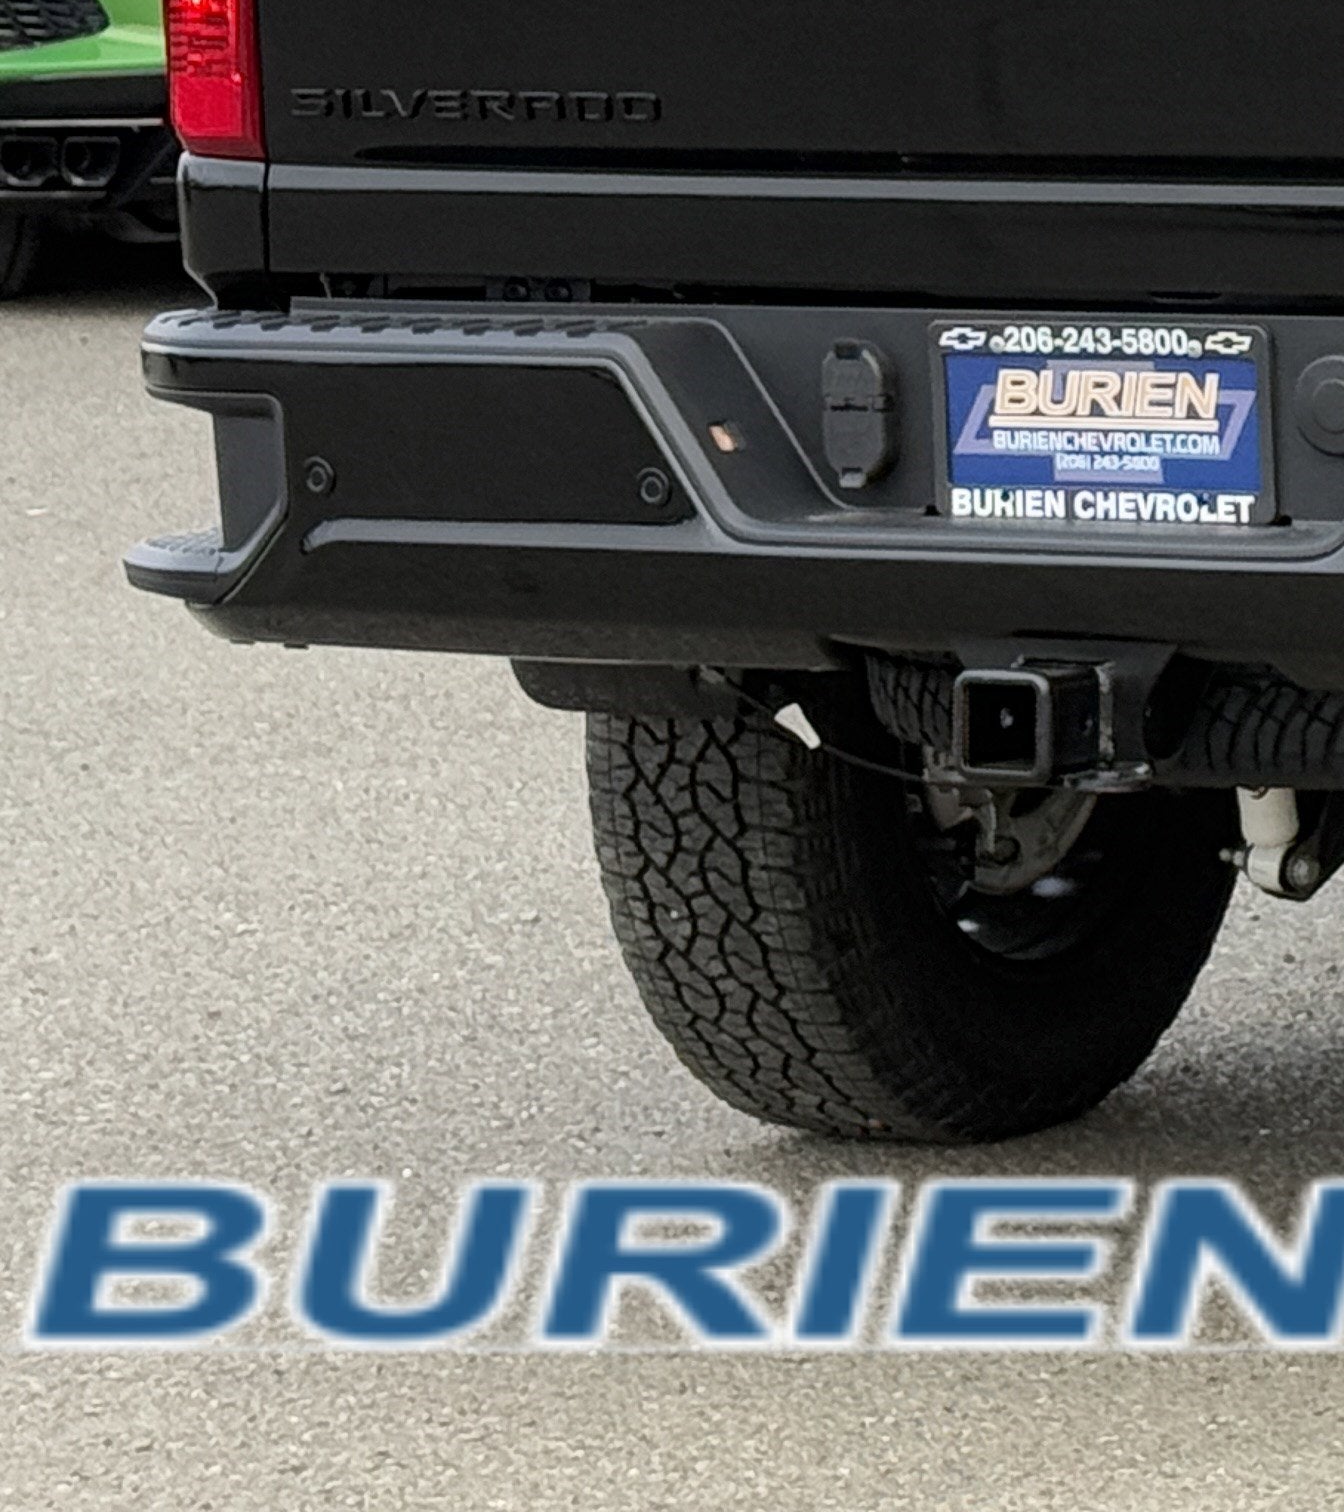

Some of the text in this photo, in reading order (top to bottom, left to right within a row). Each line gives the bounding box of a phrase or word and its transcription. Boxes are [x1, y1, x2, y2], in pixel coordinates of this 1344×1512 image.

[288, 88, 663, 122] SILVERADO
[1003, 326, 1188, 356] 206-243-5800
[993, 368, 1220, 419] BURIEN
[993, 430, 1220, 455] BURIENCHEVROLET.COM
[952, 488, 1255, 524] BURIEN CHEVROLET
